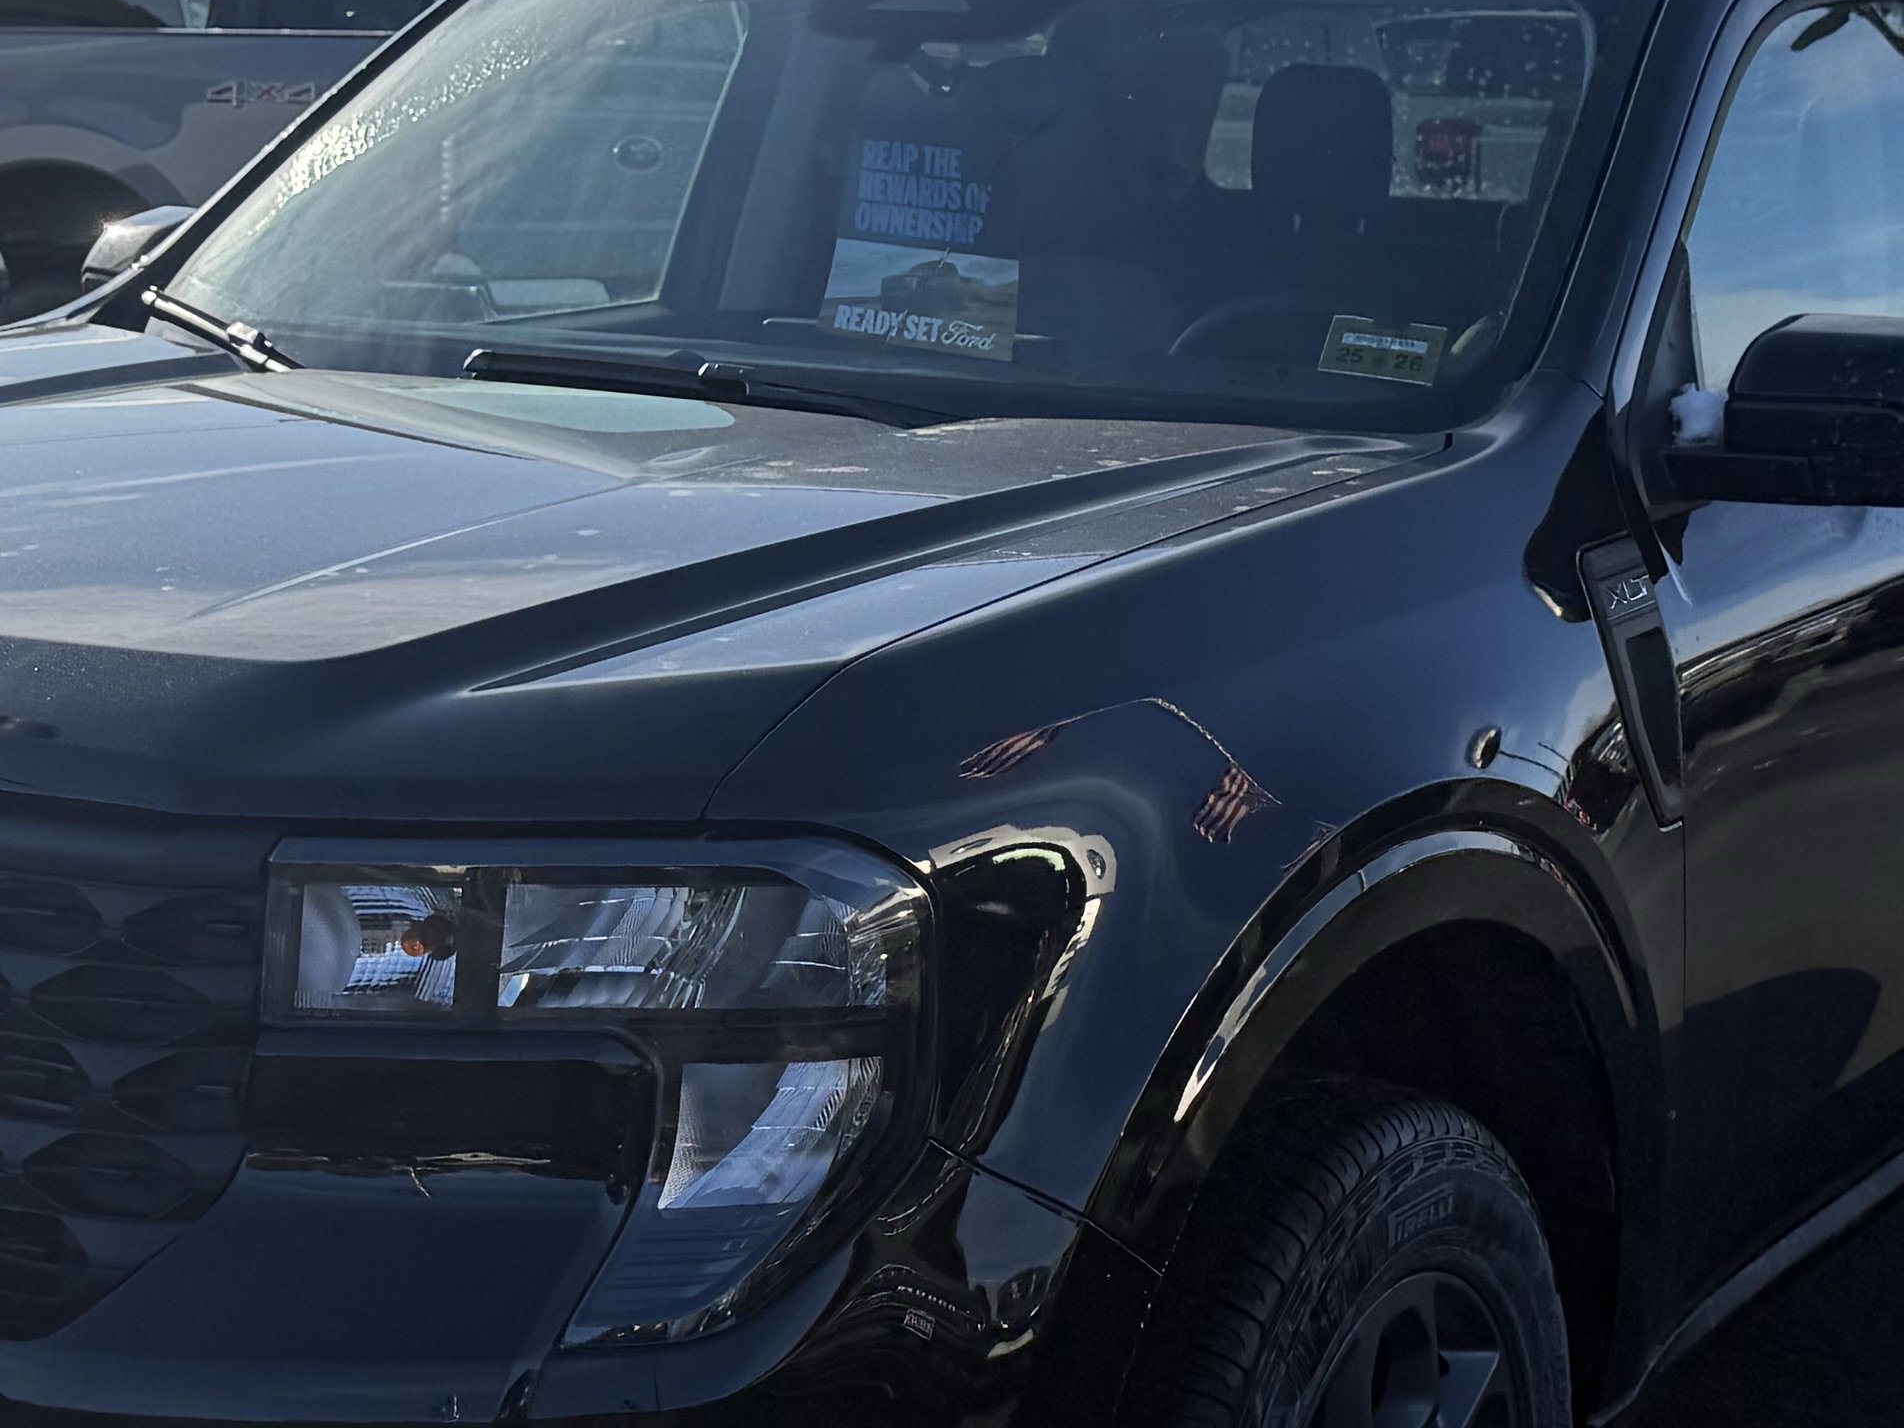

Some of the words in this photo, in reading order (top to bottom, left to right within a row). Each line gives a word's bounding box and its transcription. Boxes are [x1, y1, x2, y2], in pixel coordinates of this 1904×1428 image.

[862, 139, 921, 172] REAP
[923, 145, 963, 178] THE
[858, 170, 962, 210] REWARDS
[854, 204, 984, 245] OWNERSHIP
[834, 305, 901, 335] READY
[903, 313, 945, 343] SET
[942, 320, 998, 351] Ford
[1335, 346, 1364, 364] 25
[1393, 352, 1424, 372] 26
[1603, 574, 1650, 610] XLT
